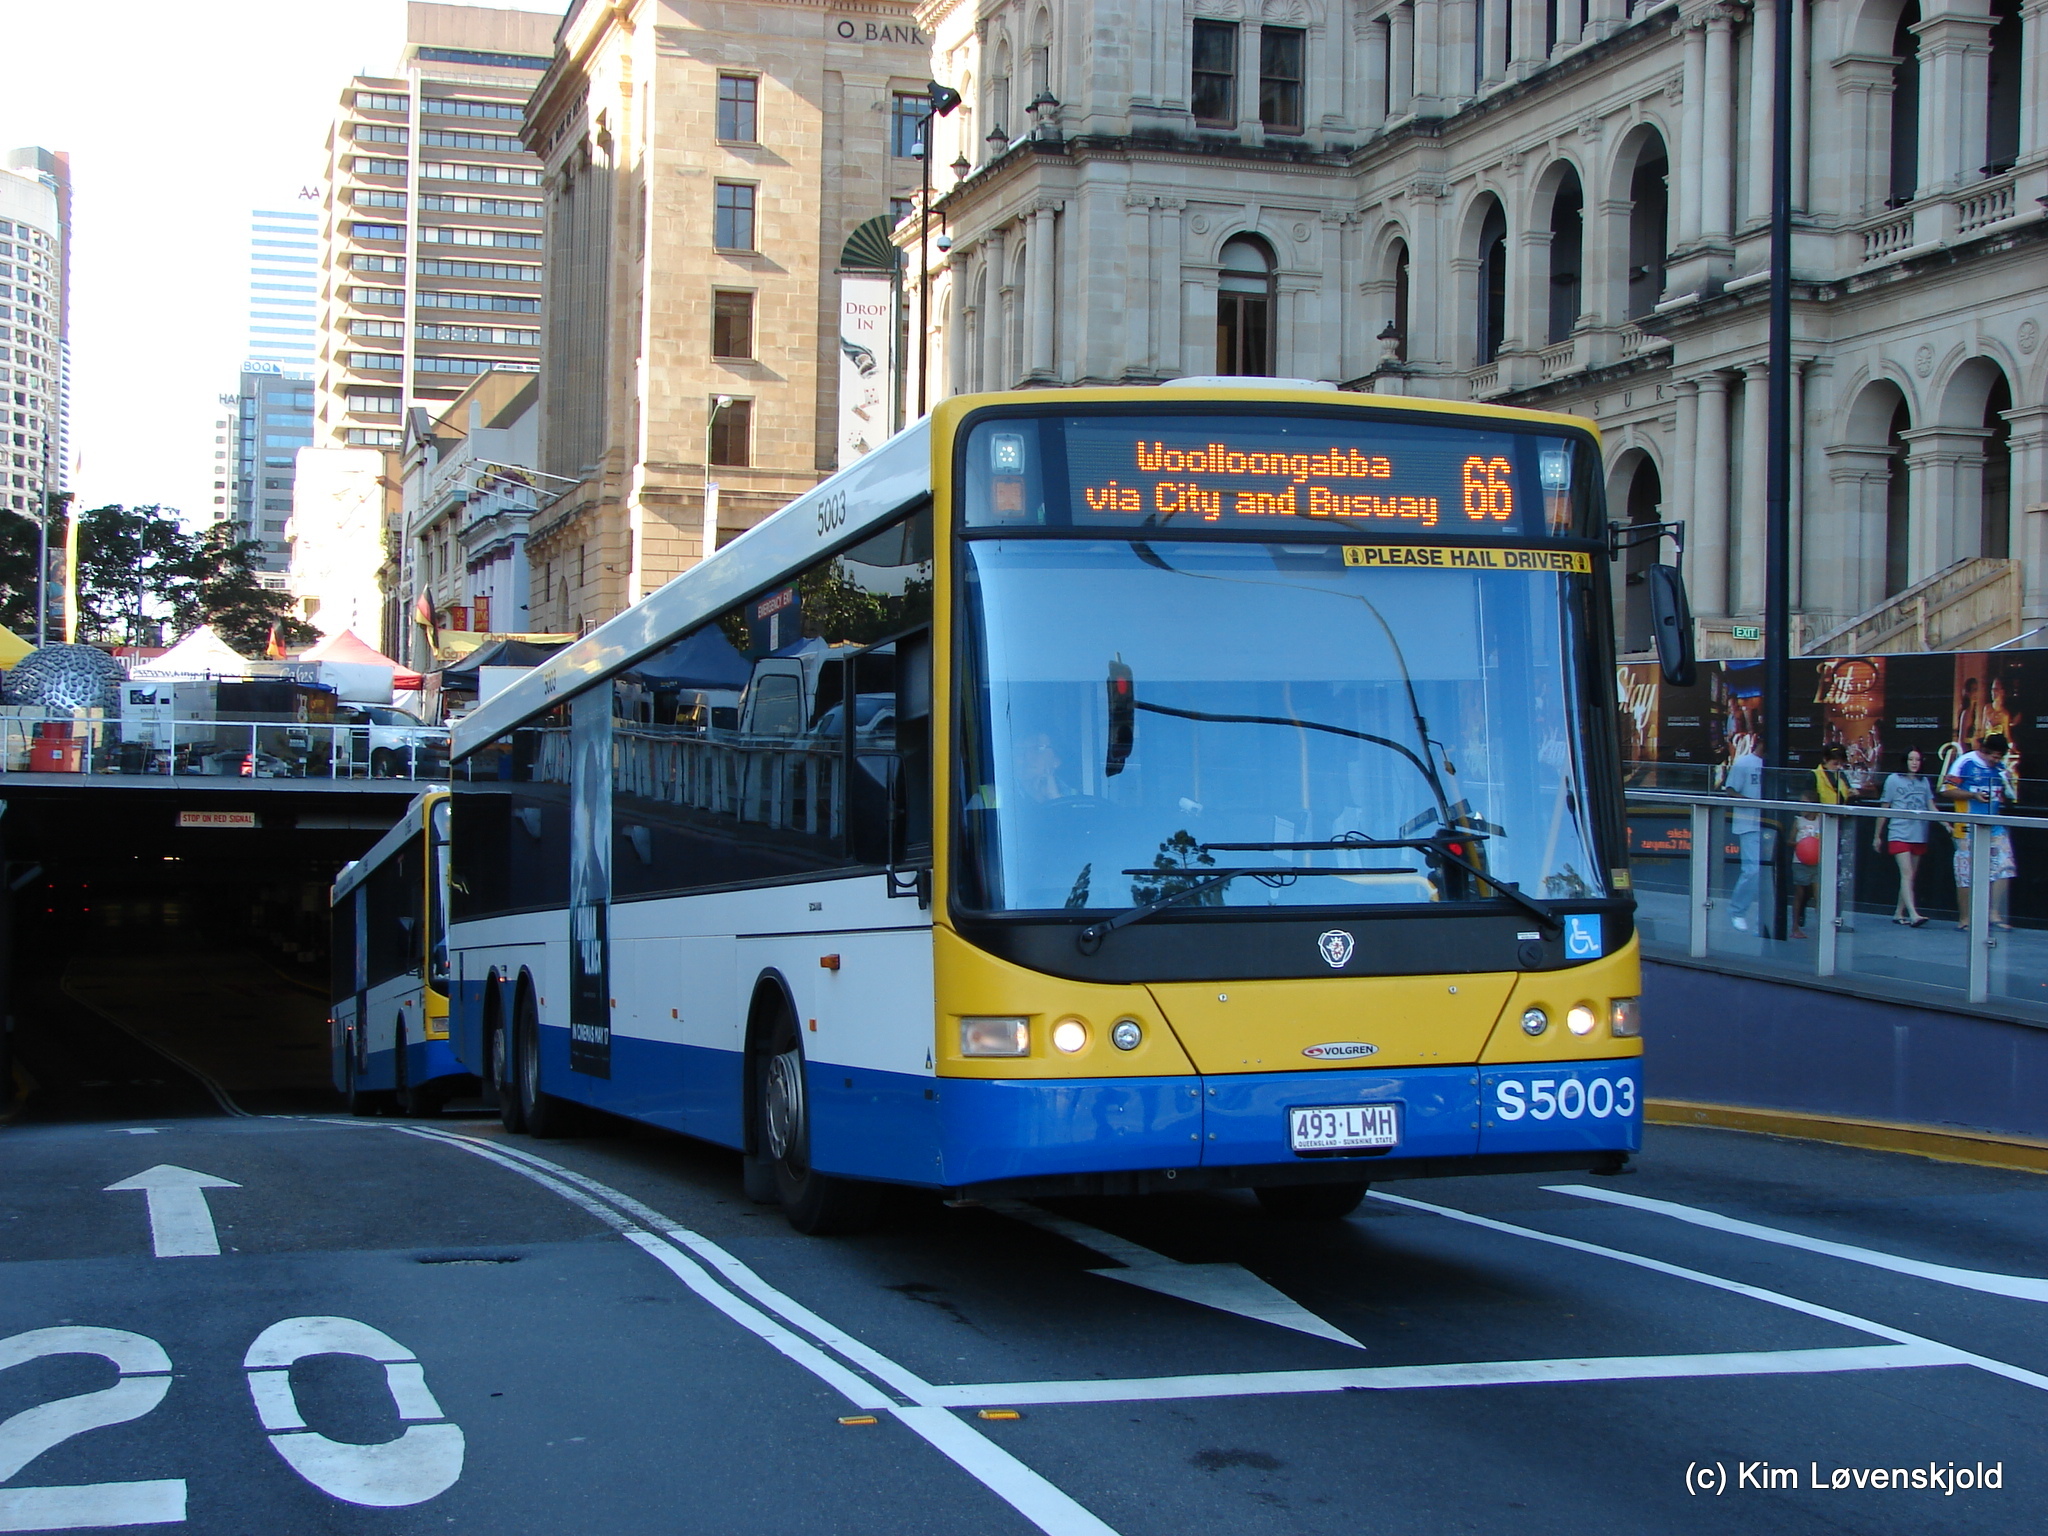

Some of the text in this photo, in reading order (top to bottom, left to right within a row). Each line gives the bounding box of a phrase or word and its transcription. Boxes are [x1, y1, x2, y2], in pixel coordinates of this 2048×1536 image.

[865, 22, 924, 44] BANK
[243, 361, 271, 372] BOQ
[1136, 440, 1392, 484] Woolloongabba
[1462, 455, 1514, 521] 66
[817, 489, 846, 537] 5003
[1085, 479, 1439, 526] via City and Busway
[1364, 548, 1574, 571] PLEASE HAIL DRIVER
[758, 595, 782, 618] EMERGENCY
[1736, 628, 1757, 637] EXIT
[183, 814, 252, 824] STOP ON RED SIGNAL
[1324, 1046, 1373, 1055] VOLGREN
[1496, 1076, 1635, 1121] S5003
[1298, 1139, 1337, 1148] QUEENSLAND
[0, 1315, 466, 1533] 20
